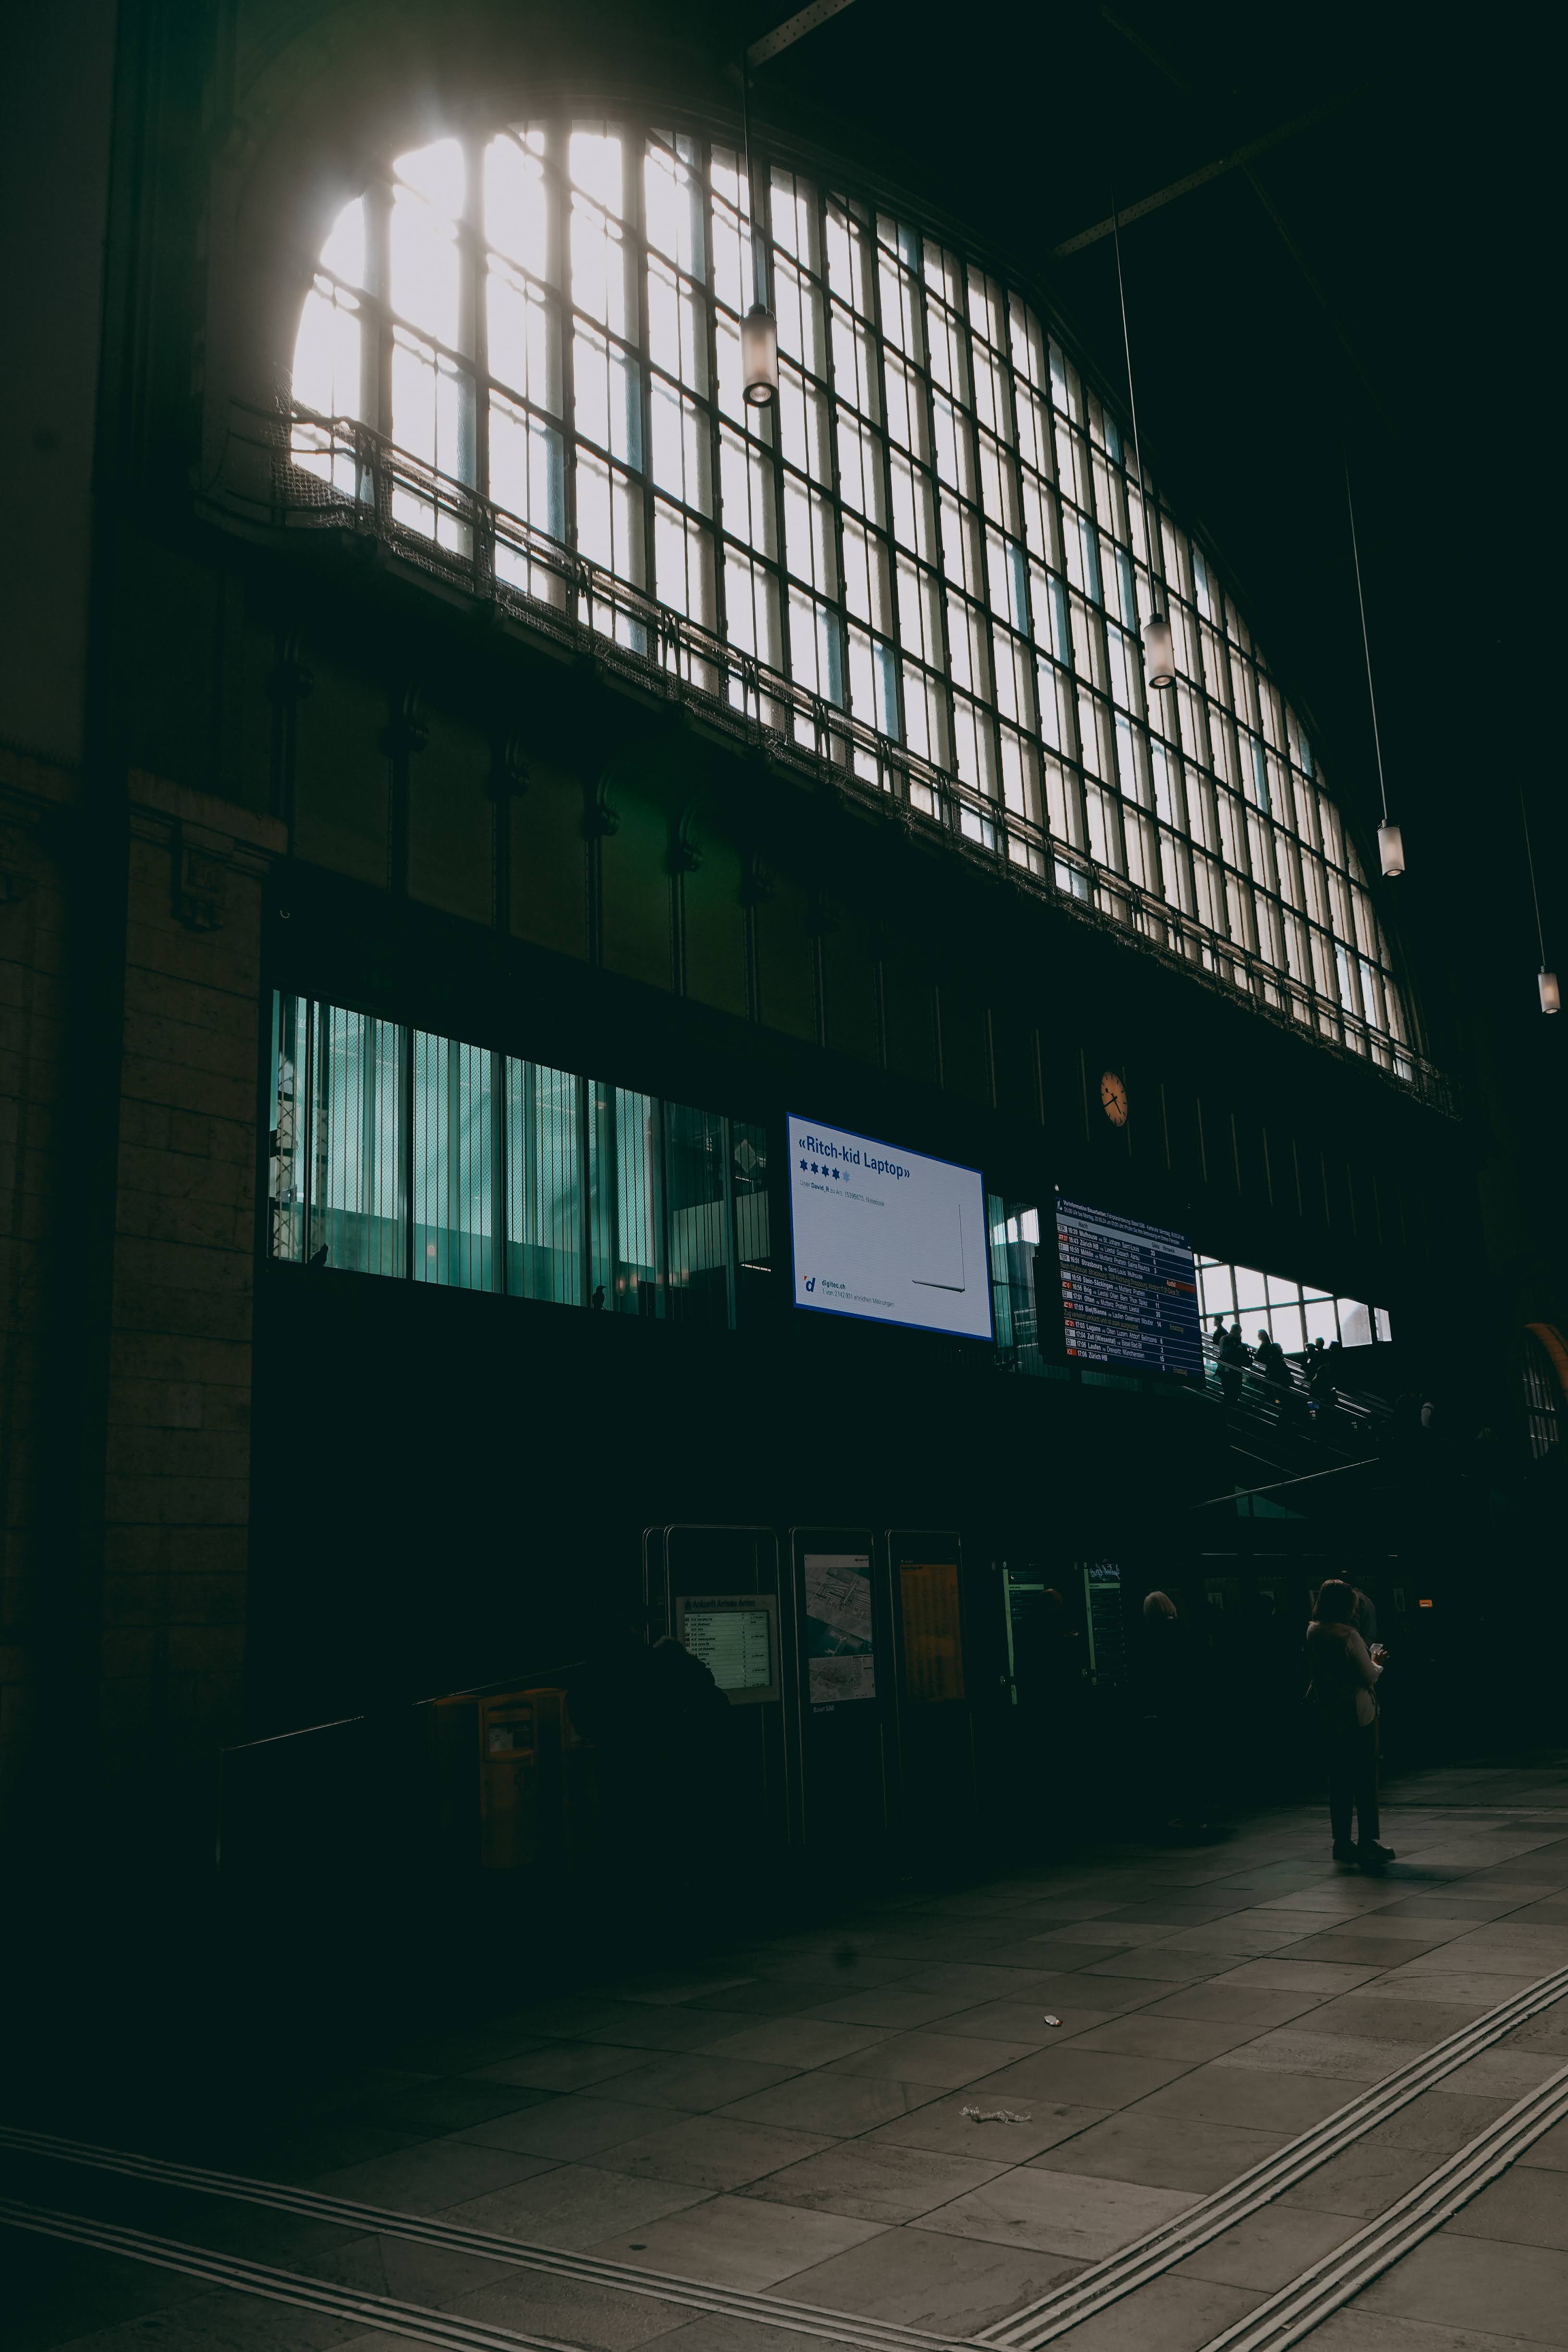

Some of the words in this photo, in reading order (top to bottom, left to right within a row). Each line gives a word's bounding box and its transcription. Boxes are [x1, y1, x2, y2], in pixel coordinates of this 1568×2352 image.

[799, 1136, 860, 1165] «Ritch-kid
[864, 1152, 910, 1180] Laptop»
[800, 1179, 810, 1188] User
[811, 1182, 829, 1193] David_R
[866, 1196, 885, 1207] Notebook
[1063, 1200, 1086, 1211] Vorinformation
[1079, 1230, 1097, 1240] Mulhouse
[1108, 1237, 1120, 1247] Johann
[1121, 1241, 1139, 1252] Saint-Louis
[1069, 1246, 1079, 1254] 16:50
[1081, 1249, 1094, 1258] Möhlin
[1079, 1239, 1092, 1248] Zürich
[1104, 1246, 1115, 1254] Liestal
[1130, 1252, 1140, 1261] Aarau
[1070, 1256, 1079, 1264] 16:51
[1081, 1259, 1103, 1271] Strasbourg
[1108, 1265, 1126, 1275] Saint-Louis
[1127, 1270, 1143, 1280] Mulhouse
[822, 1280, 846, 1290] digitec.ch
[1082, 1276, 1113, 1290] Stein-Säckingen
[854, 1295, 872, 1303] ehrlichen
[873, 1298, 894, 1308] Meinungen
[1072, 1283, 1082, 1291] 16:56
[1083, 1285, 1092, 1295] Brig
[1097, 1289, 1108, 1297] Liestal
[1138, 1298, 1148, 1307] Spiez
[1073, 1292, 1082, 1300] 17:01
[1084, 1295, 1094, 1303] Olten
[1129, 1305, 1139, 1313] Liestal
[1085, 1306, 1106, 1317] Biel/Bienne
[1112, 1311, 1123, 1320] Laufen
[1086, 1323, 1101, 1334] Lugano
[1095, 1334, 1116, 1345] (Wiesental)
[1077, 1349, 1087, 1358] 17:06
[1088, 1352, 1101, 1360] Zürich
[1087, 1342, 1101, 1351] Laufen
[1106, 1346, 1121, 1356] Dreispitz
